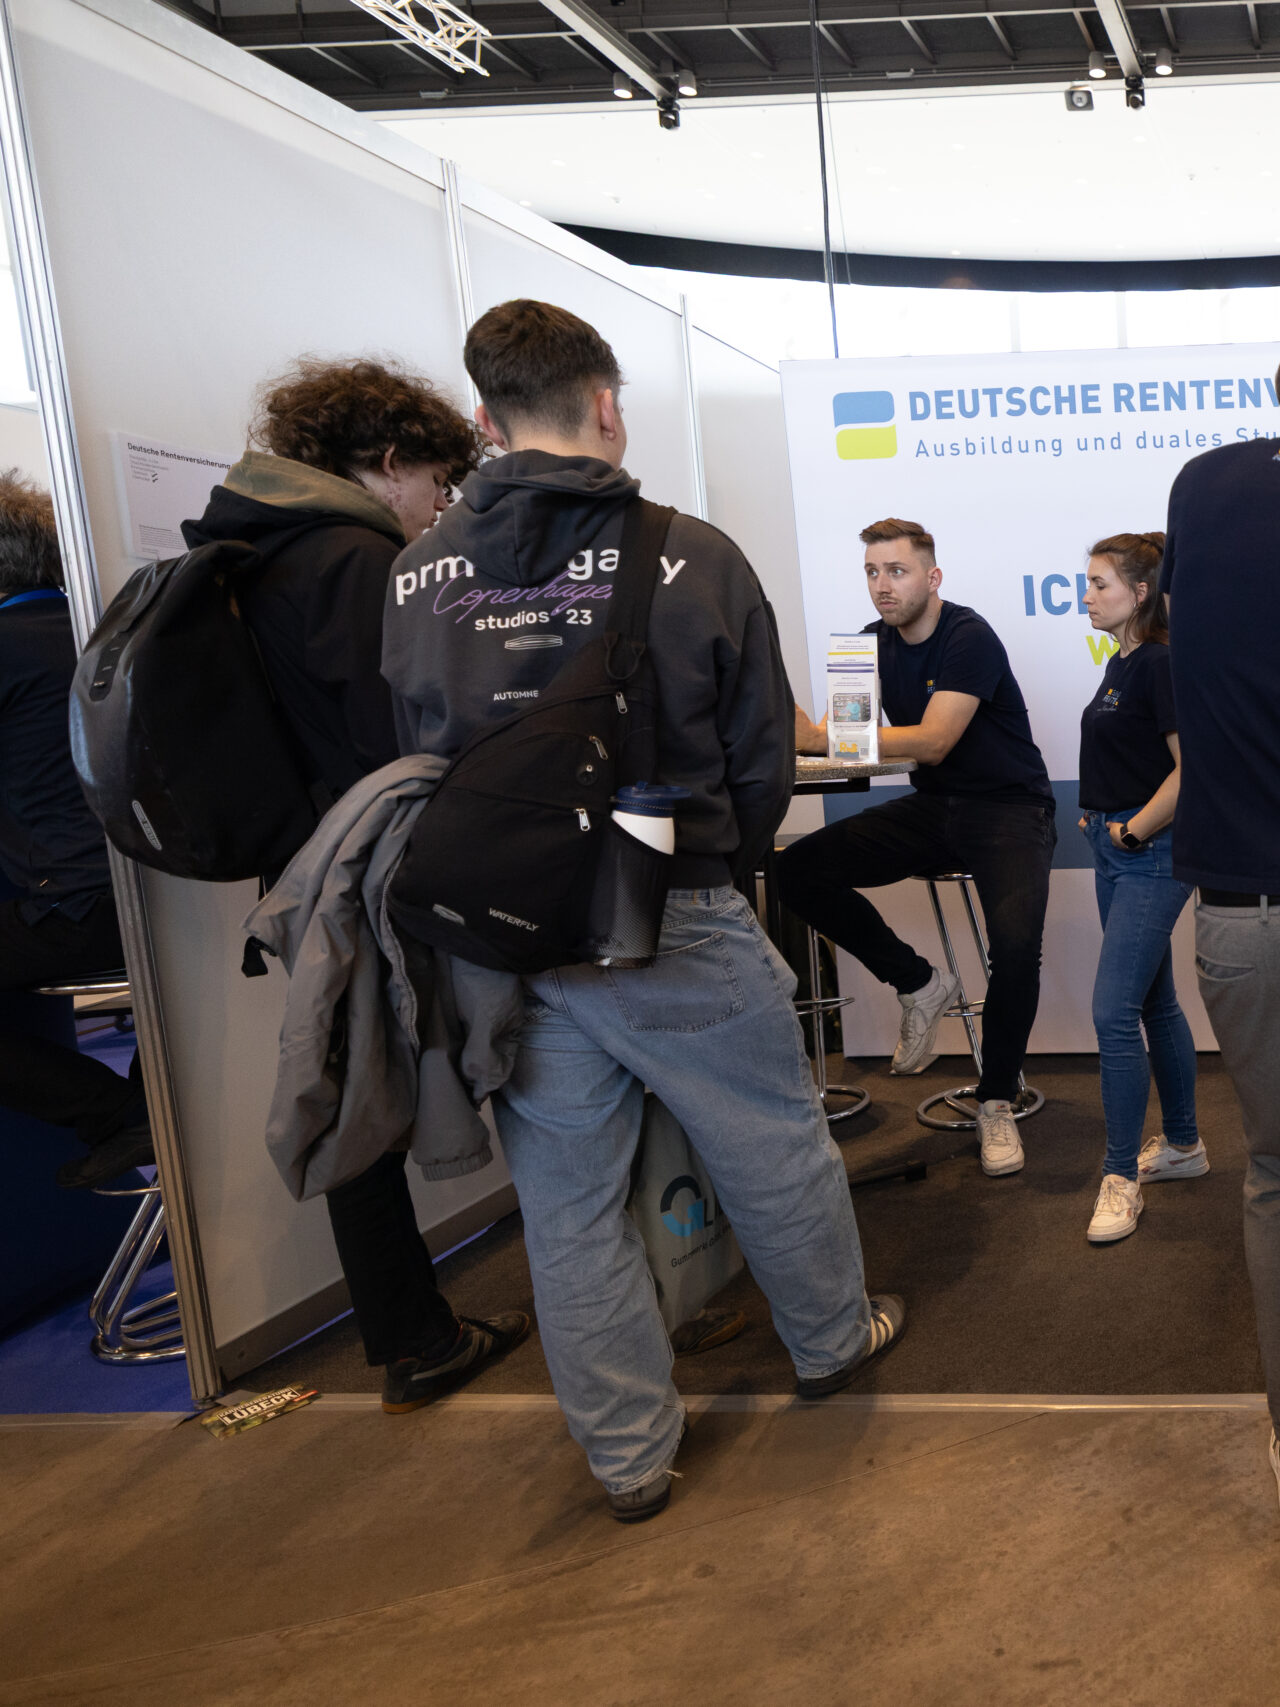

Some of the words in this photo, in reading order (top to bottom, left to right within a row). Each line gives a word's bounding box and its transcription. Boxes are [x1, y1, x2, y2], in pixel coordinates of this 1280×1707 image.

[909, 383, 1102, 421] DEUTSCHE
[127, 442, 159, 457] Deutsche
[160, 449, 231, 471] Rentenversicherung
[915, 435, 1063, 458] Ausbildung
[1077, 431, 1122, 452] und
[1136, 429, 1223, 450] duales
[432, 569, 613, 624] Copenhage
[474, 609, 550, 631] studios
[565, 609, 593, 625] 23
[493, 689, 540, 702] AUTOMNE
[488, 906, 541, 932] WATERFLY
